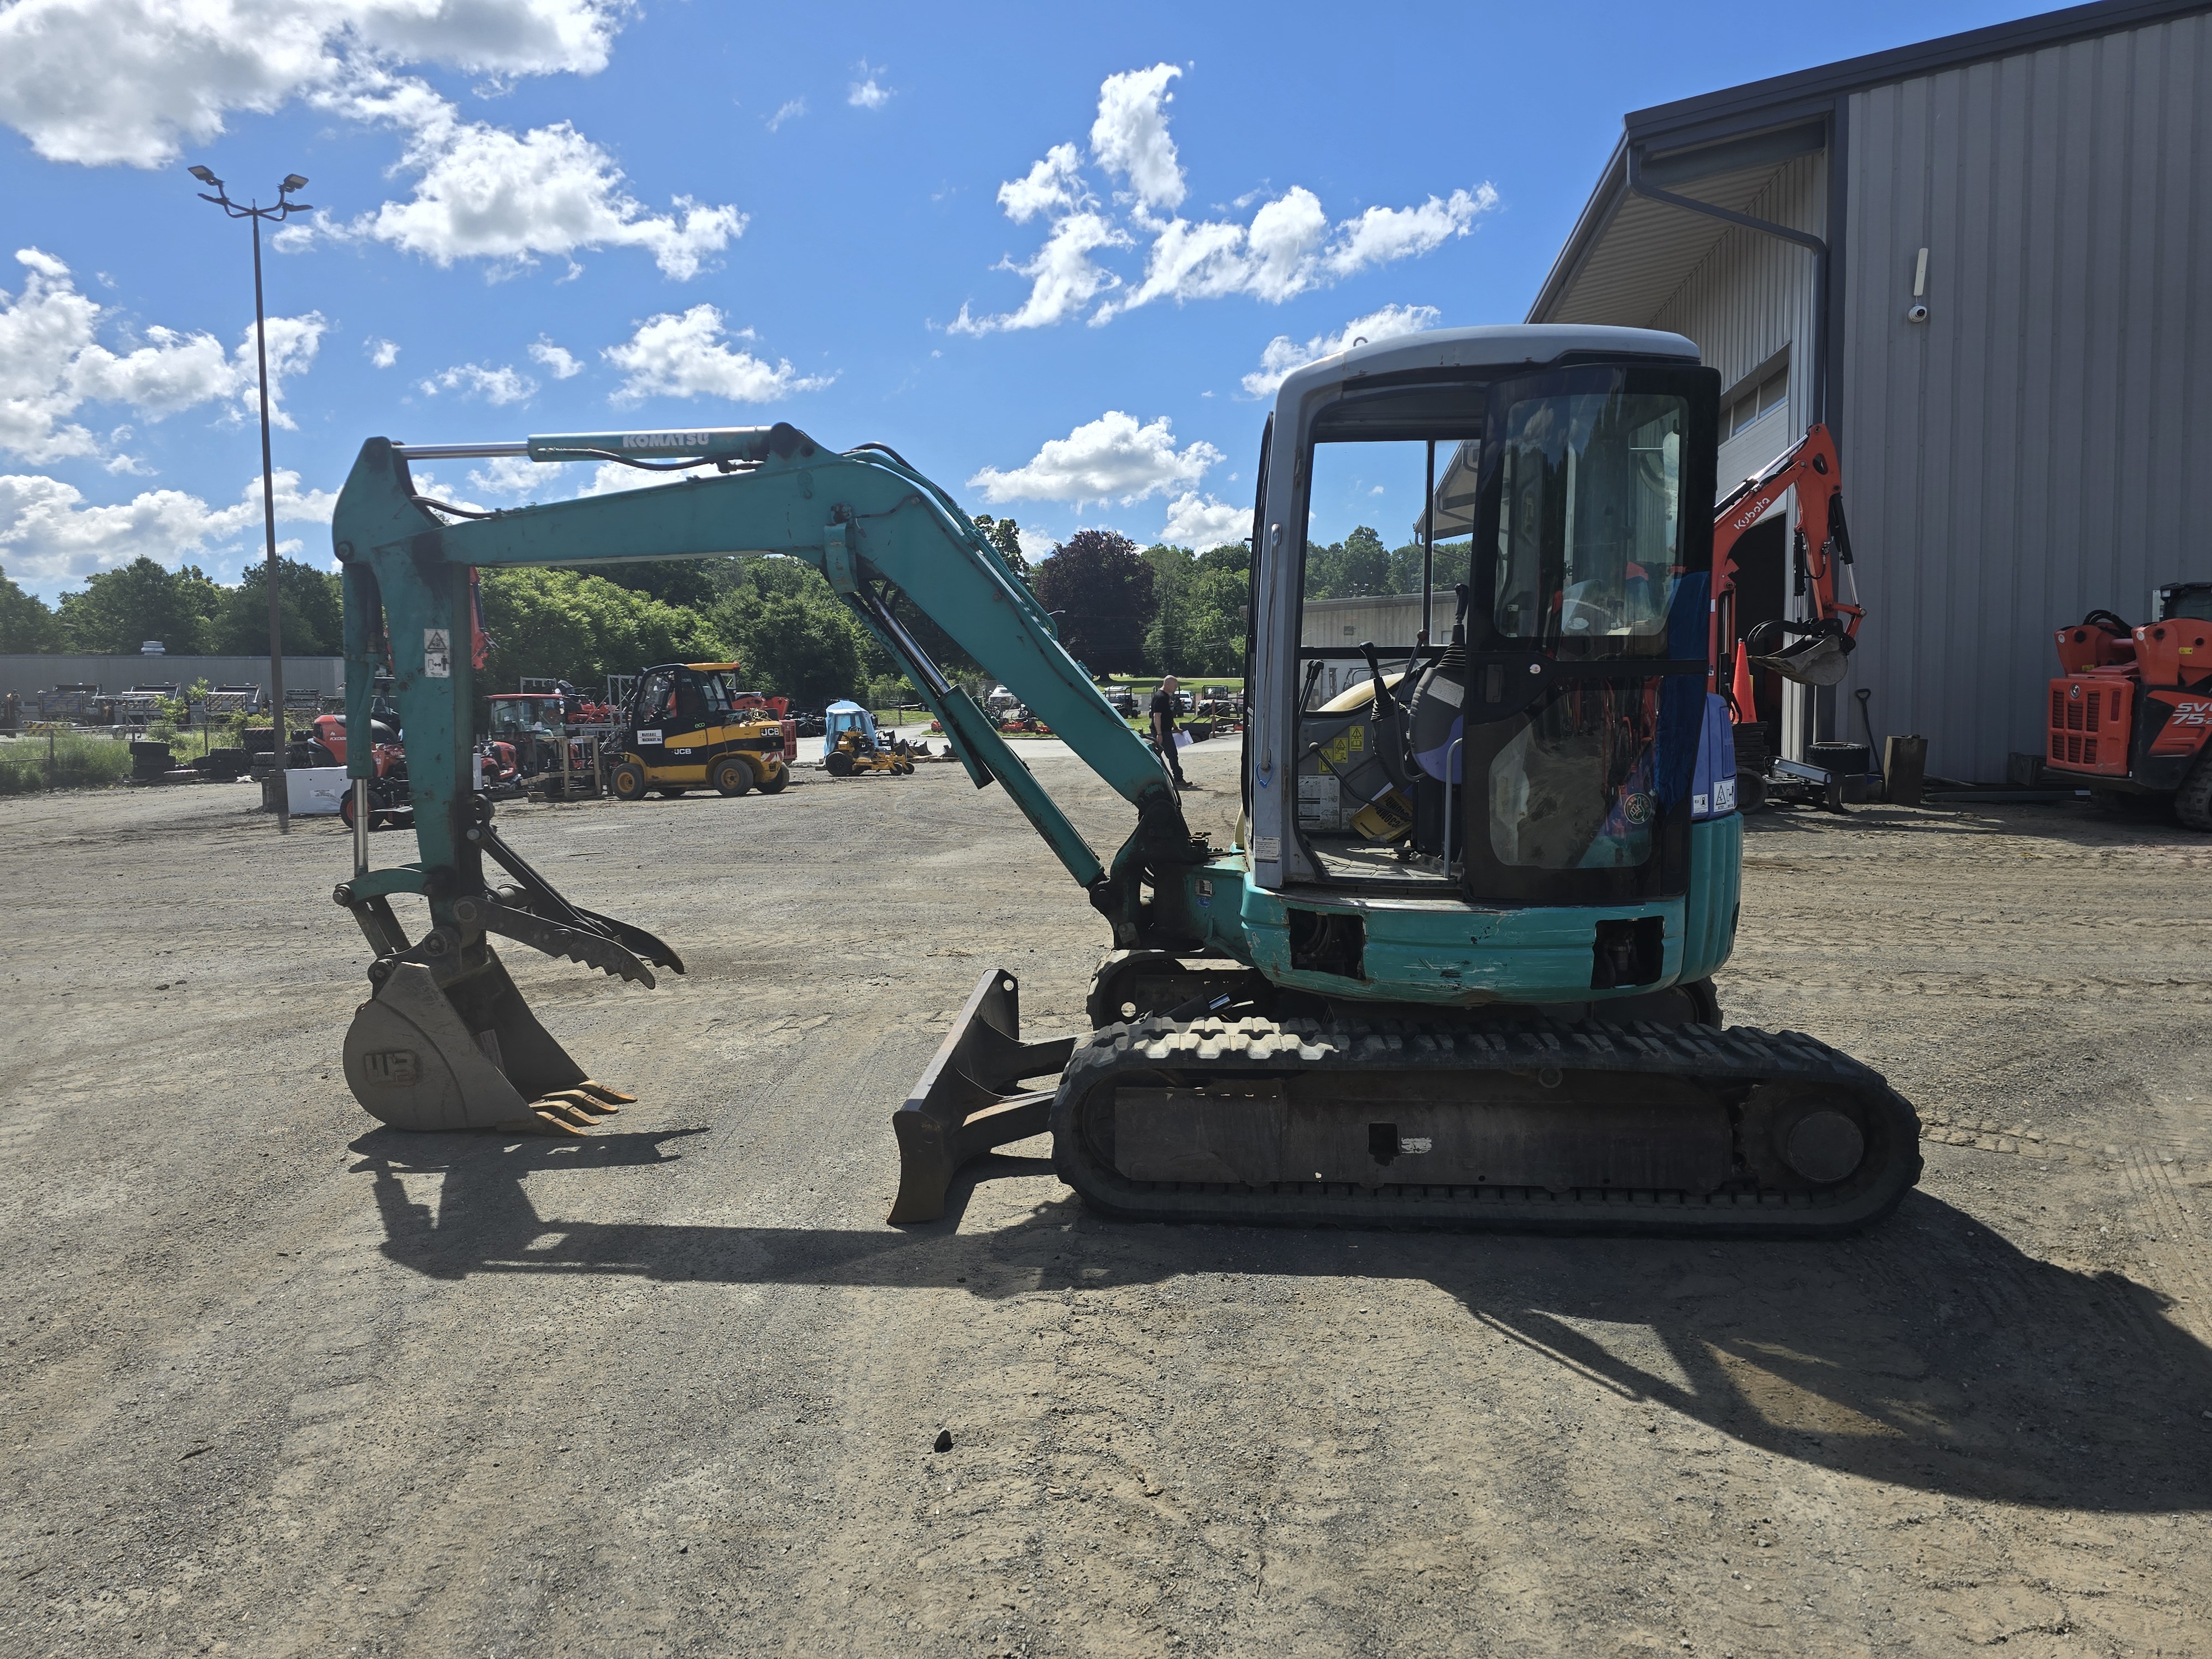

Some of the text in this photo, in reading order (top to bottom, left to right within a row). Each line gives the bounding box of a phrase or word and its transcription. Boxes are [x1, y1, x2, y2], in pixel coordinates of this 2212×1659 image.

[623, 432, 709, 447] KOMATSU
[1734, 498, 1770, 529] Kubota
[760, 728, 779, 736] JCB
